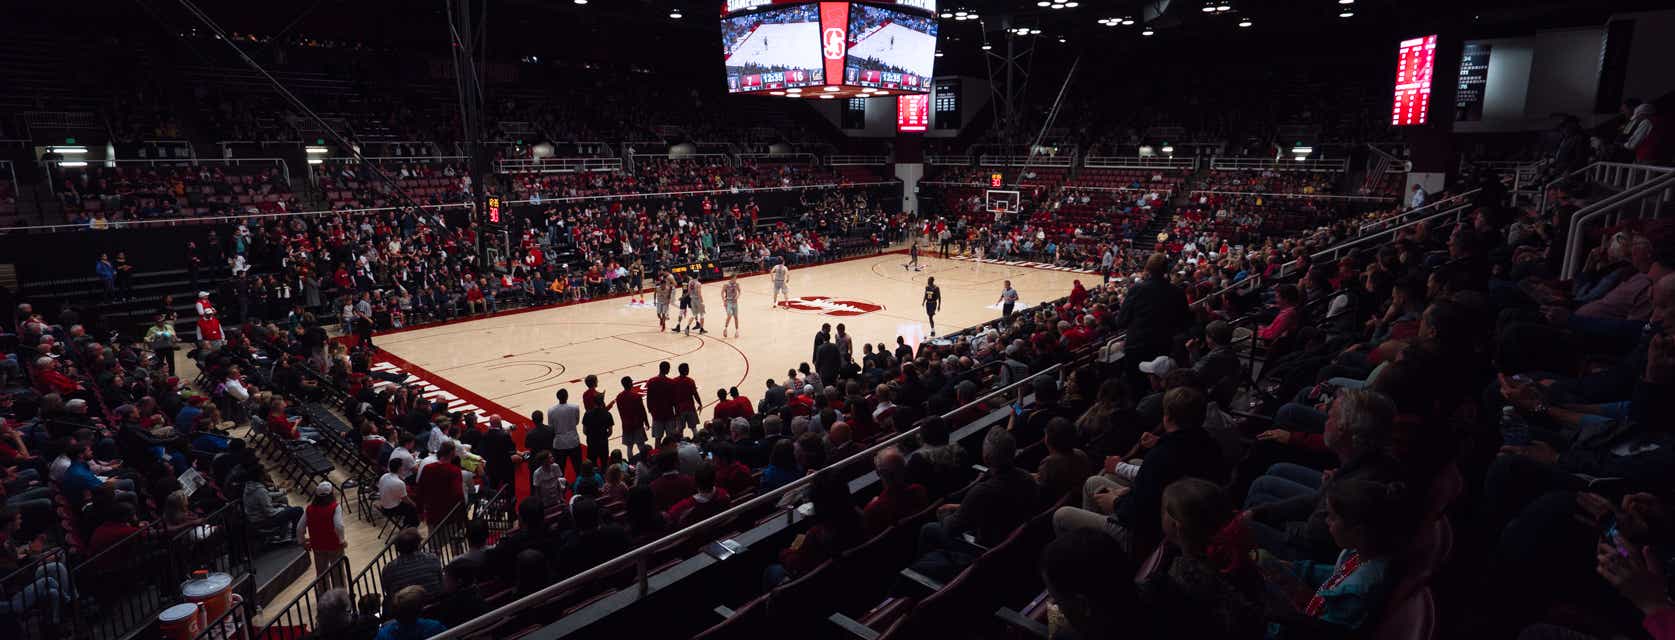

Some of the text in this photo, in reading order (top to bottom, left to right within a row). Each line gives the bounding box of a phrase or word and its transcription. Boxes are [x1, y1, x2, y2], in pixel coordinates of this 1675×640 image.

[747, 76, 753, 86] 7
[763, 71, 784, 82] 12:35
[793, 71, 803, 82] 16
[866, 71, 873, 81] 7
[882, 73, 901, 83] 12:35
